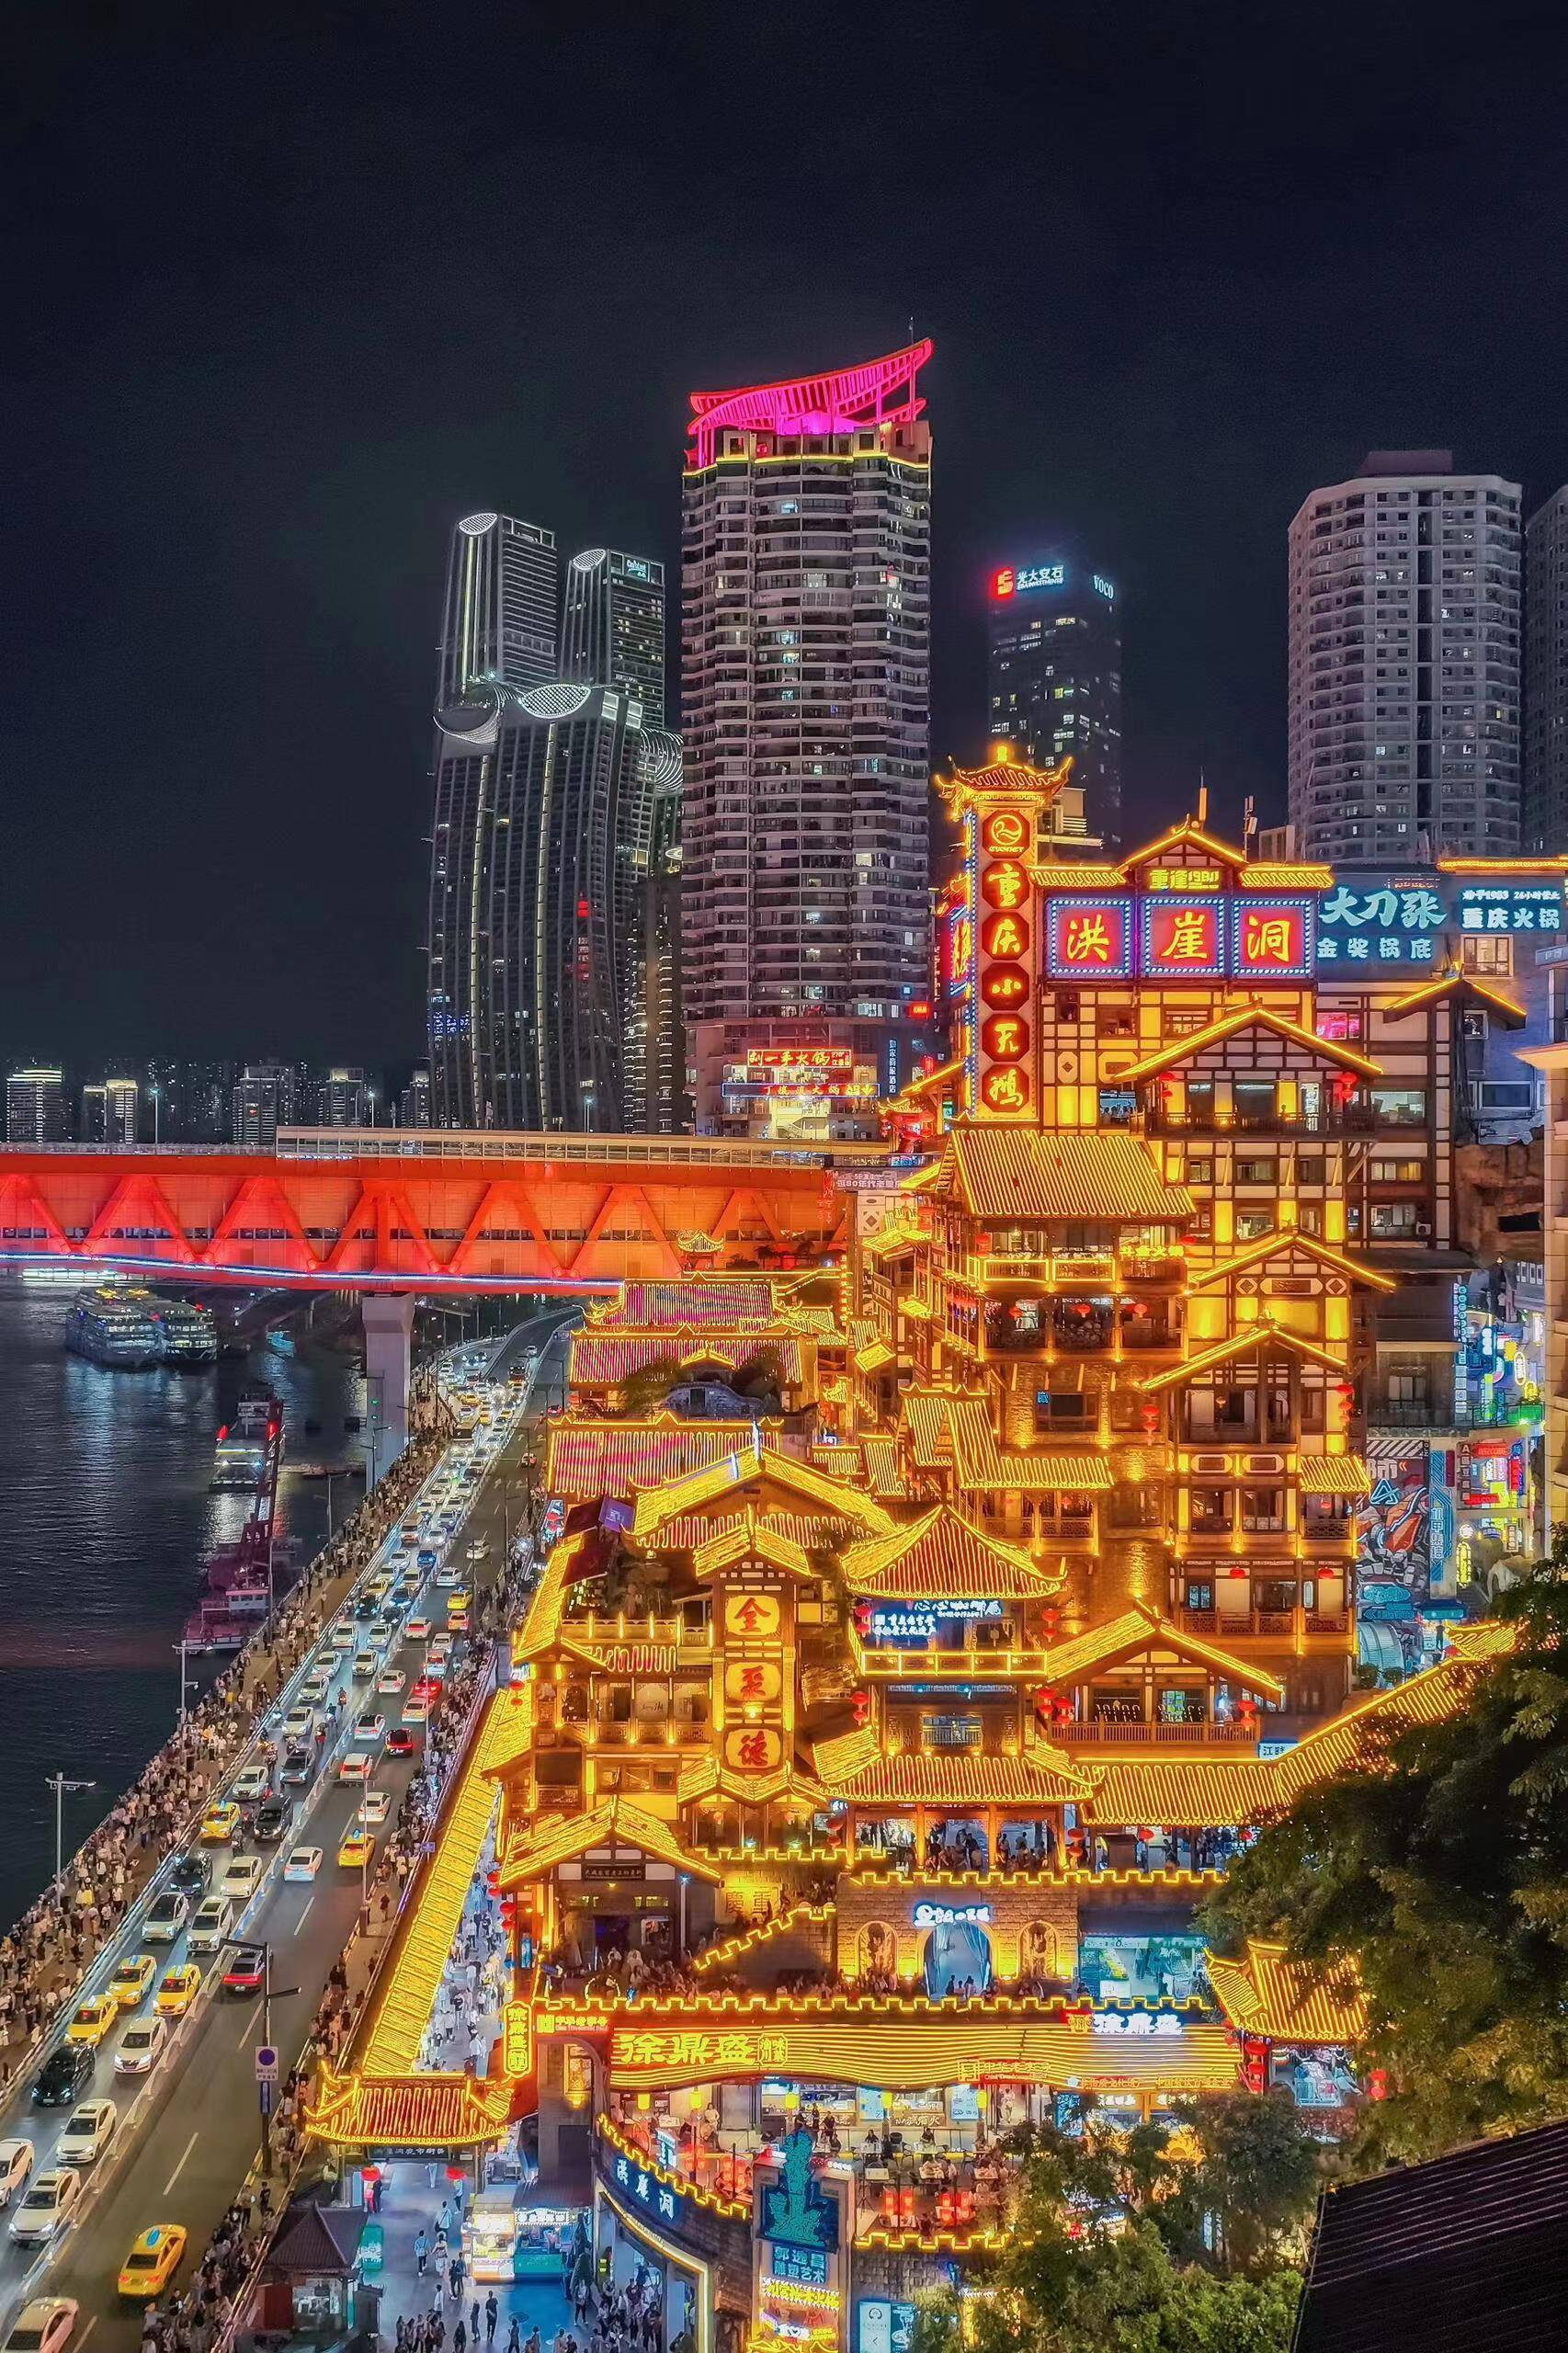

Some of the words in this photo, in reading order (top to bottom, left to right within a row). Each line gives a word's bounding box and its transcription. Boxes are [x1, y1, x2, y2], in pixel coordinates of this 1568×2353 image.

[1017, 564, 1064, 584] 光大安石
[1462, 907, 1561, 929] 重庆火锅
[1066, 911, 1290, 962] 洪崖洞
[1317, 938, 1432, 959] 金奖锅底
[733, 1597, 772, 1767] 全聚德
[617, 2032, 756, 2066] 徐鼎盛
